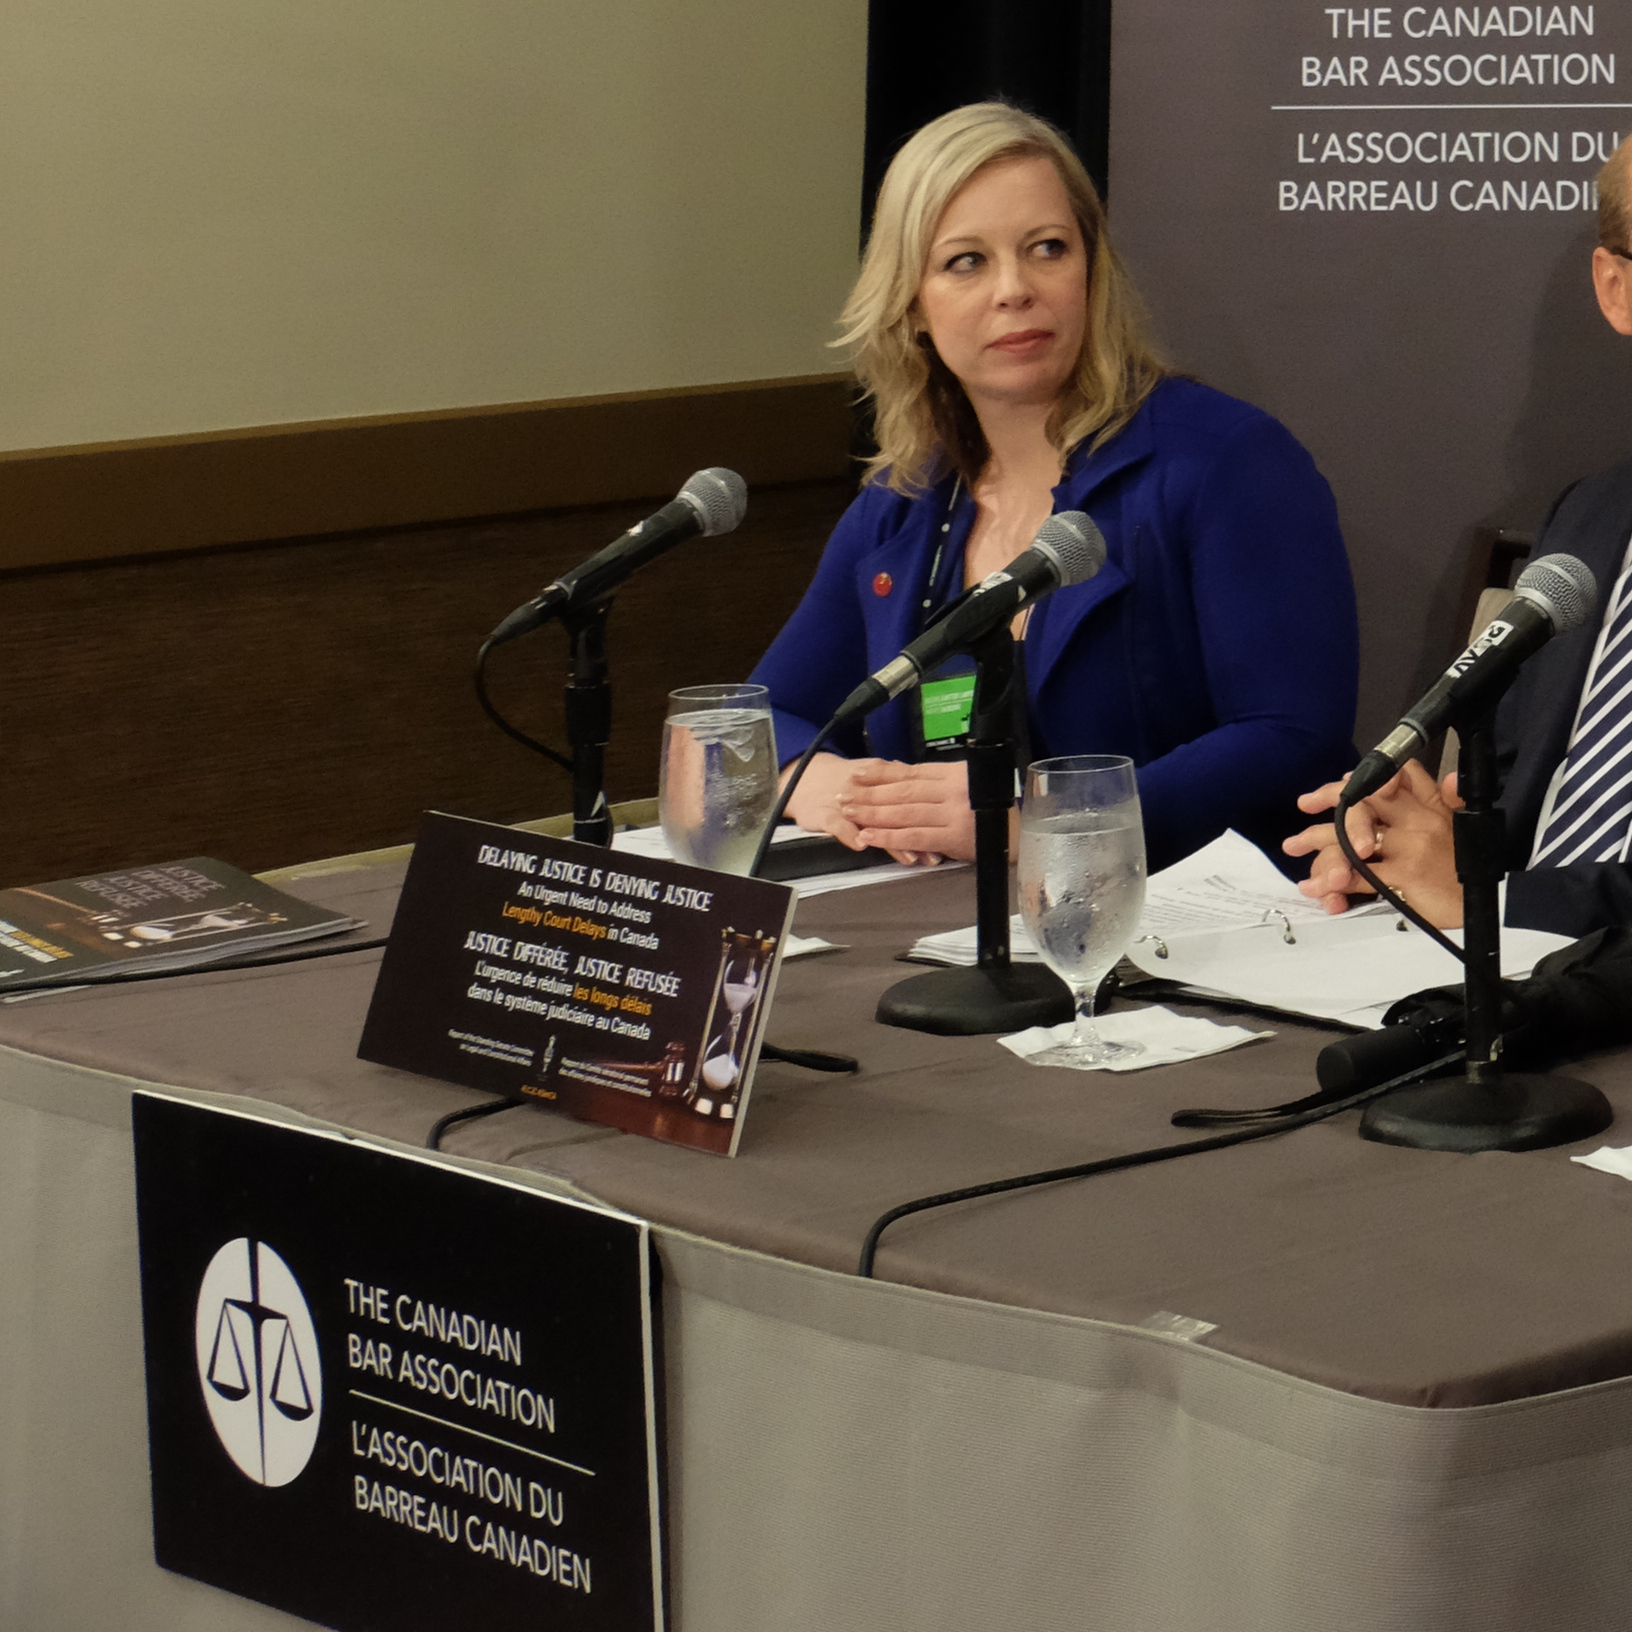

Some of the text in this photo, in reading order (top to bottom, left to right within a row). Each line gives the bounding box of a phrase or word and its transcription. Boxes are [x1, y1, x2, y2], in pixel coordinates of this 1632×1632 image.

[1324, 5, 1594, 39] THE CANADIAN
[1301, 53, 1615, 87] BAR ASSOCIATION
[1297, 131, 1559, 164] L'ASSOCIATION
[1278, 179, 1599, 212] BARREAU CANADI
[344, 1278, 521, 1366] THE CANADIAN
[348, 1333, 555, 1433] BAR ASSOCIATION
[352, 1420, 563, 1526] L'ASSOCIATION DU
[354, 1475, 591, 1594] BARREAU CANADIEN
